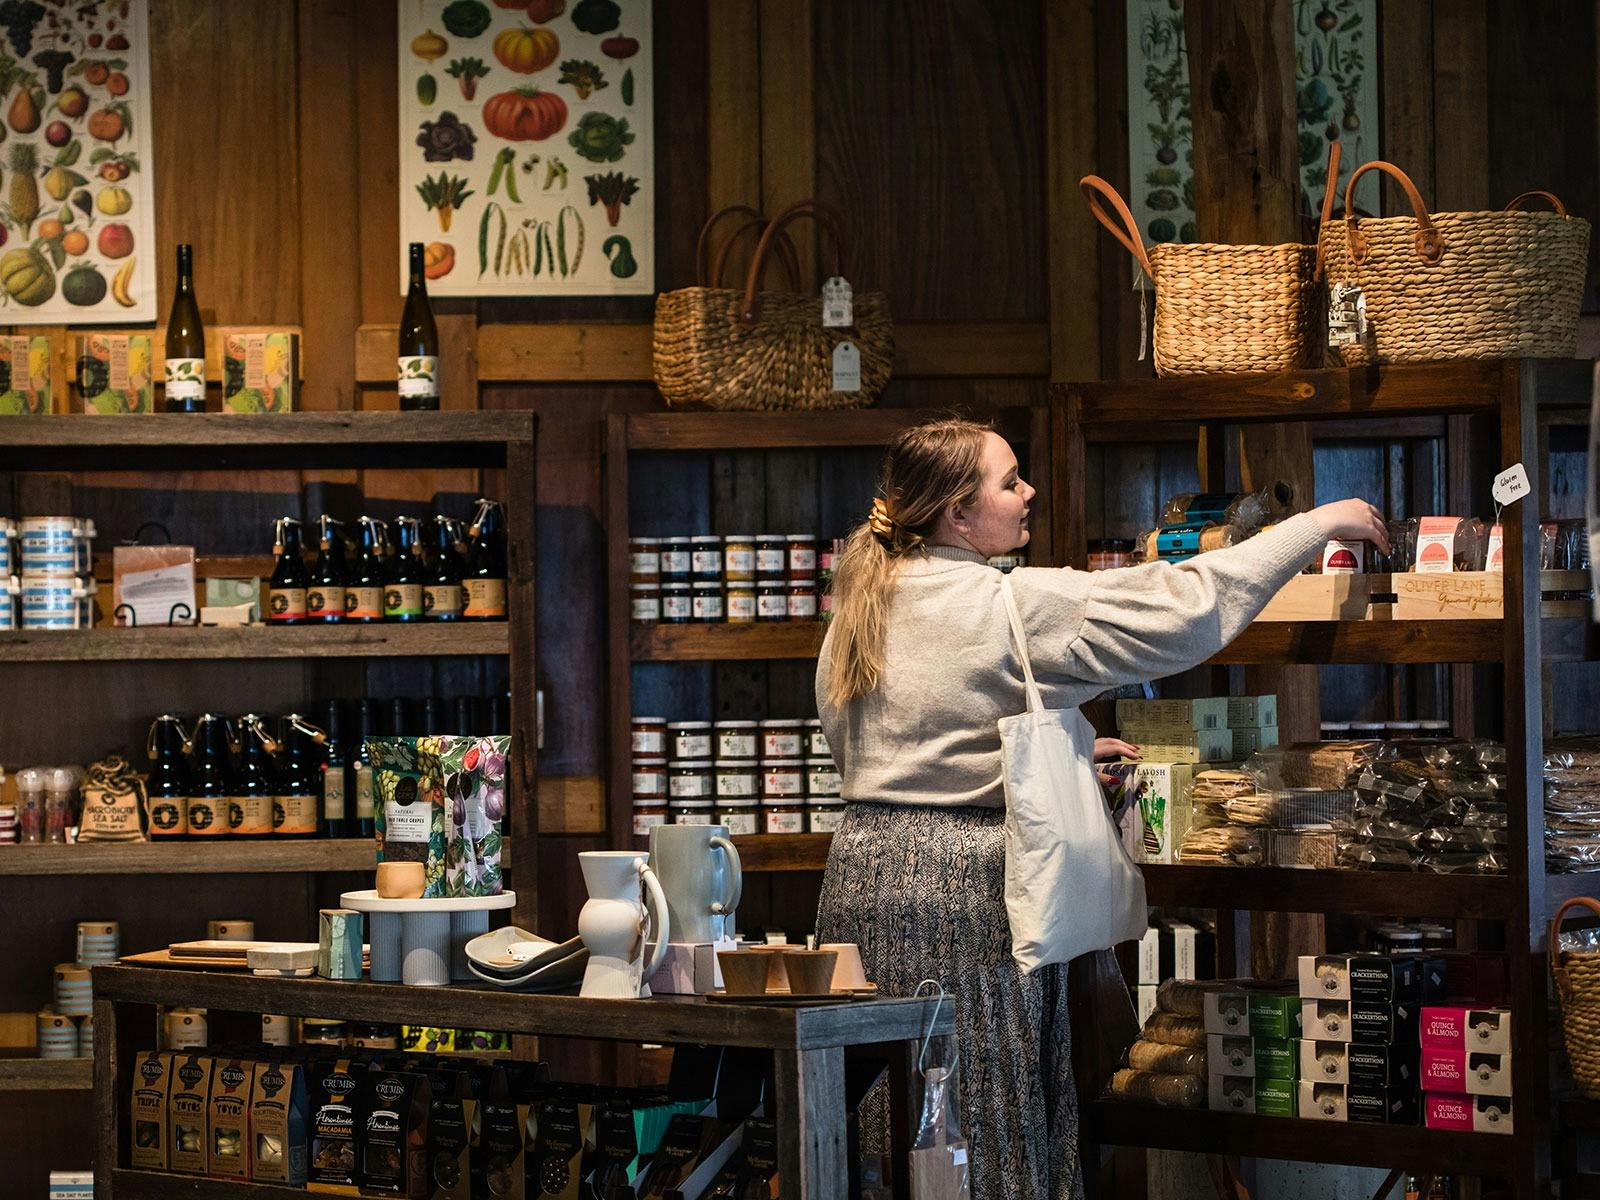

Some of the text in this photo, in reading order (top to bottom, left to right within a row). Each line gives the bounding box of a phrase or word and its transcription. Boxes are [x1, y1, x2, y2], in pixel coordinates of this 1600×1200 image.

[1509, 483, 1522, 493] Free
[1405, 579, 1487, 592] OLIVER LANE
[1137, 769, 1166, 777] LAVOSH
[1430, 1021, 1455, 1029] QUINCE
[1434, 1029, 1459, 1037] ALMOND
[1431, 1062, 1456, 1071] QUINCE
[1427, 1069, 1460, 1079] & ALMOND
[322, 1078, 356, 1089] CRUMBS
[375, 1083, 404, 1094] CRUMBS
[175, 1101, 201, 1112] YOYOS
[215, 1103, 242, 1115] YOYOS
[1437, 1104, 1463, 1112] QUINCE
[1438, 1111, 1467, 1120] ALMOND
[317, 1125, 353, 1134] MACADAMIA
